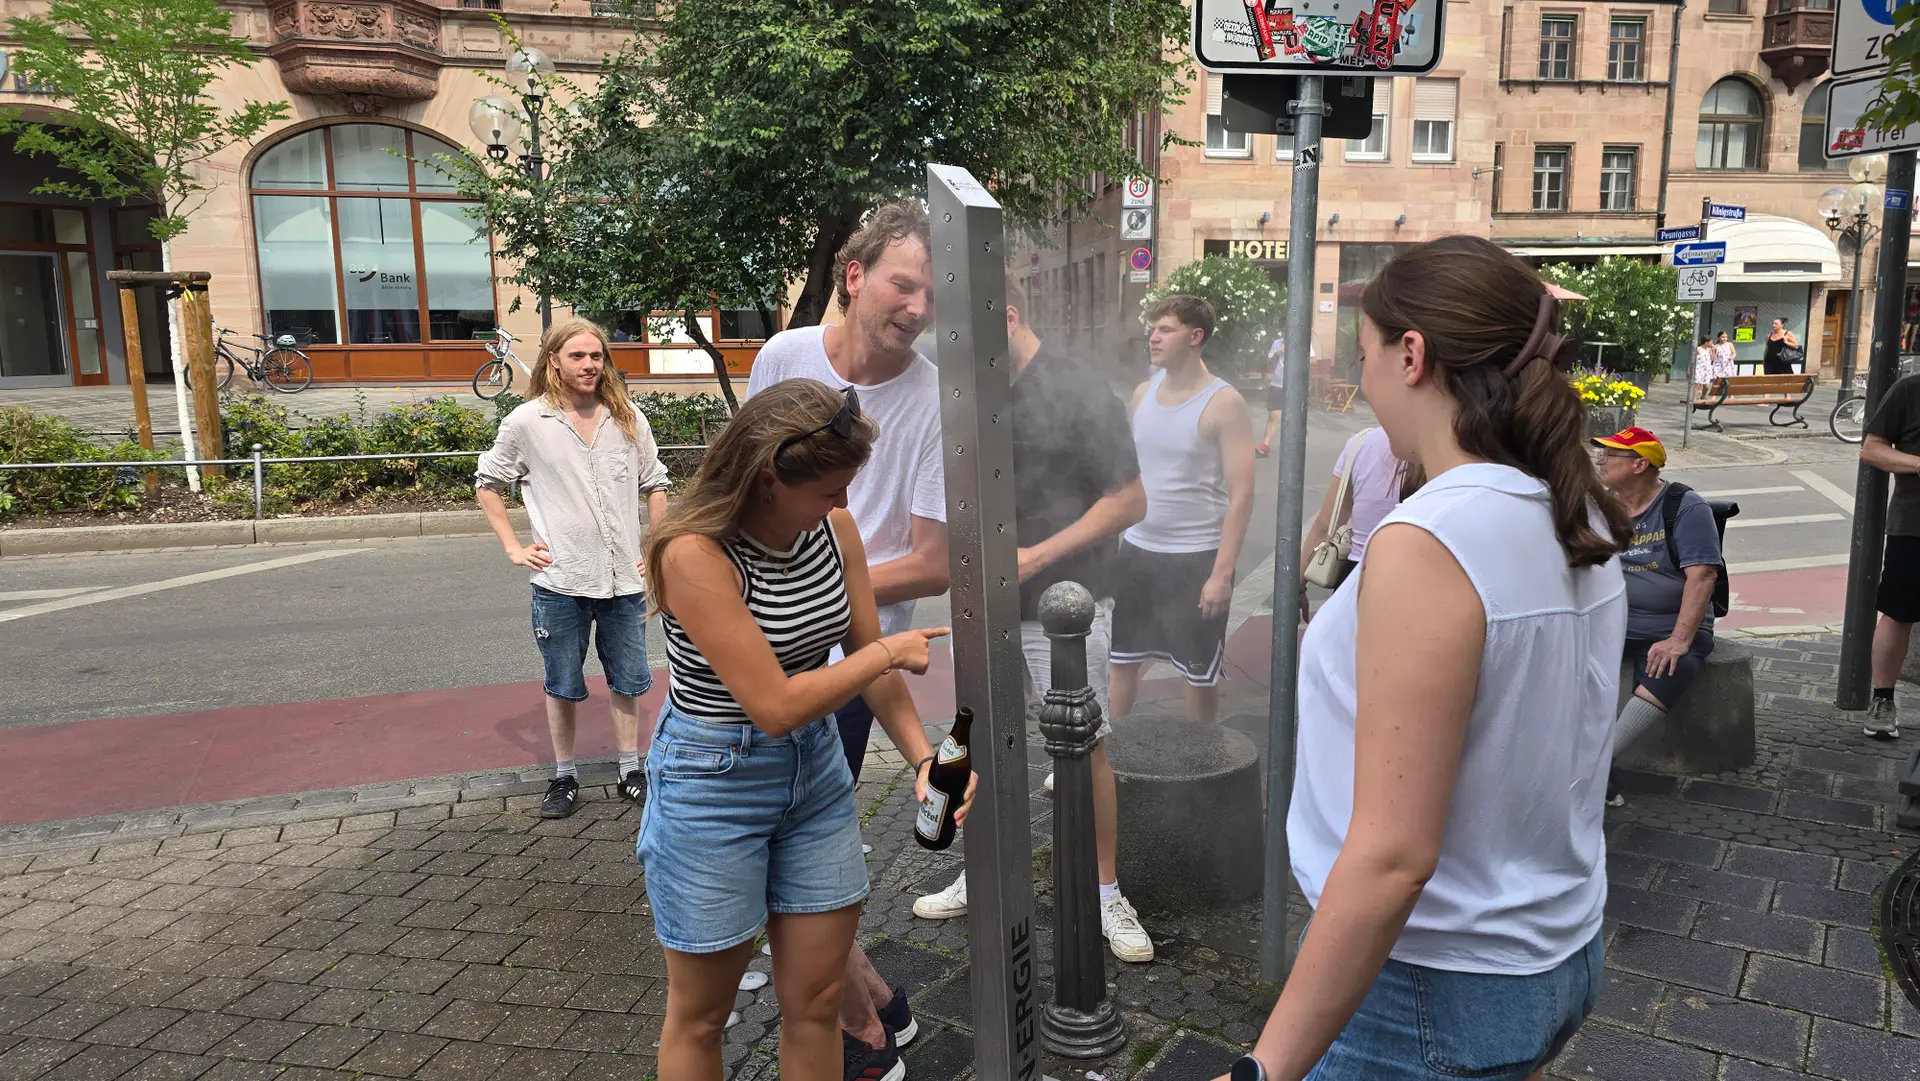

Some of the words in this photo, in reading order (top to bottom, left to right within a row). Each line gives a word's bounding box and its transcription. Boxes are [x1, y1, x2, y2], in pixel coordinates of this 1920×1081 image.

[1305, 27, 1328, 44] RAPID
[1340, 56, 1365, 66] MEH
[1133, 182, 1145, 193] 30
[1711, 205, 1743, 218] Königstraße
[380, 272, 411, 283] Bank
